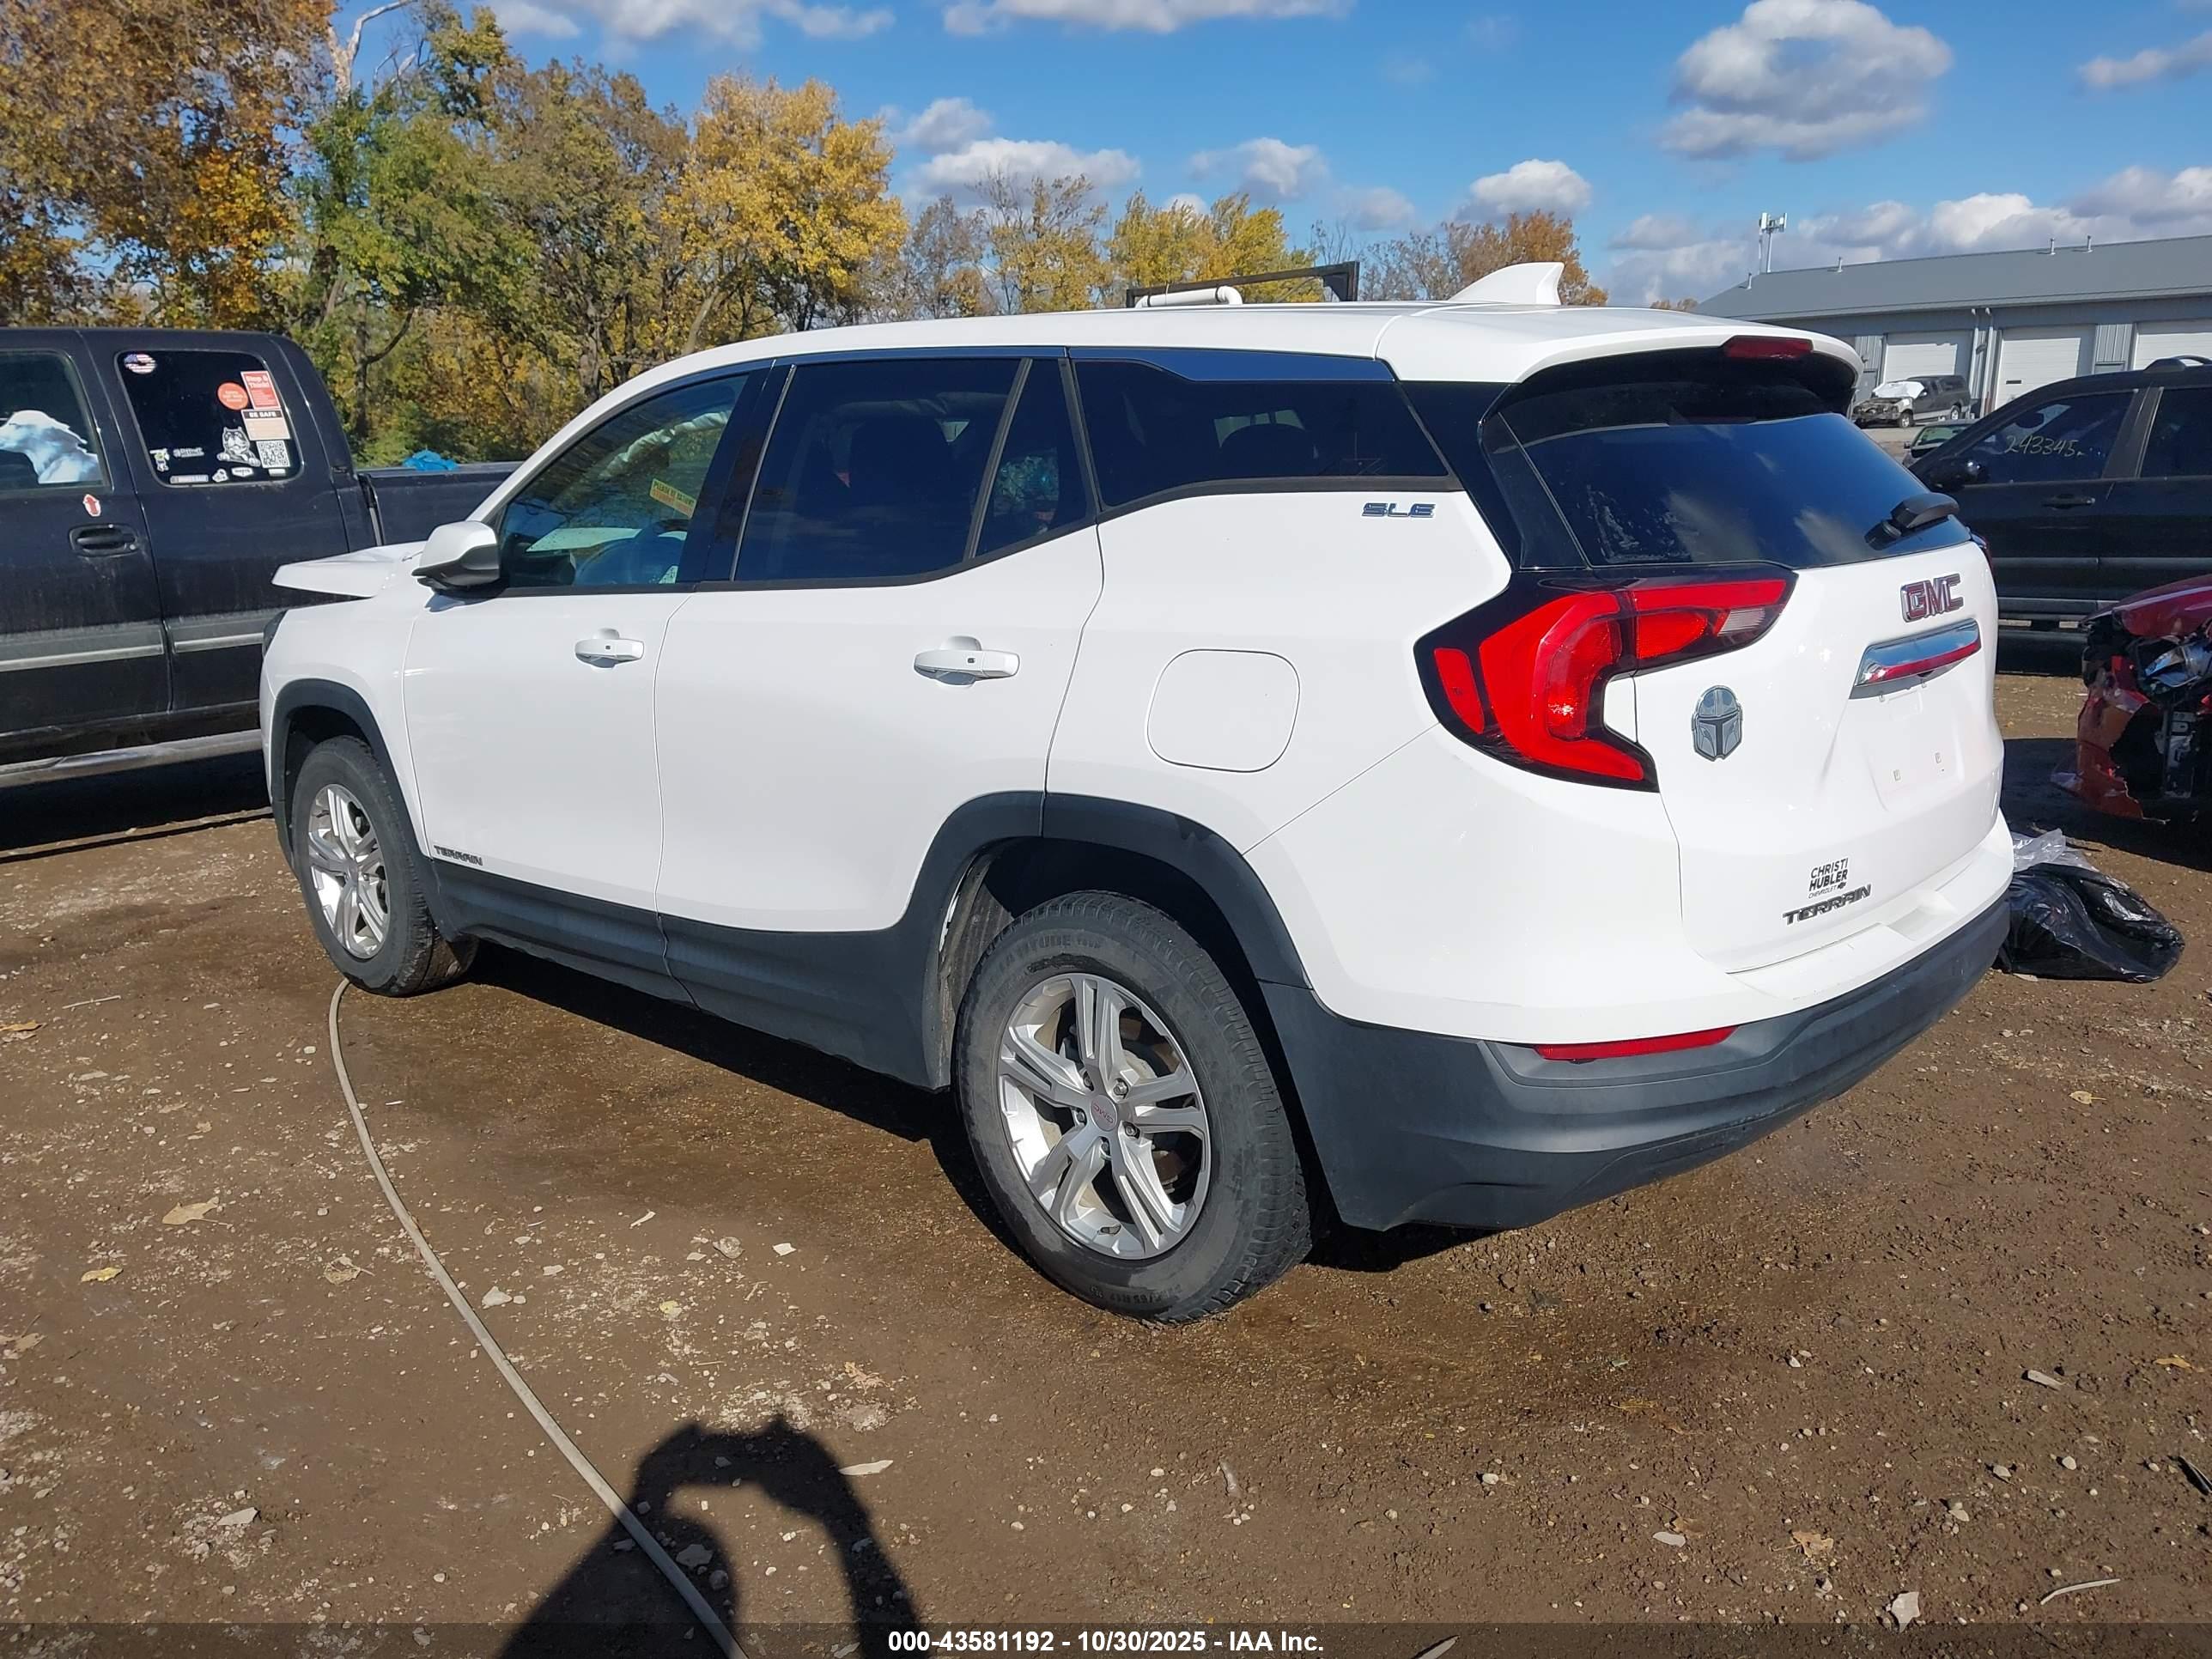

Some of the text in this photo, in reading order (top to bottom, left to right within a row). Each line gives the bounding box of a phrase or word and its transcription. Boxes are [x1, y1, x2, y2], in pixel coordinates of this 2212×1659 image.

[1362, 502, 1436, 518] SLE
[1900, 573, 1964, 623] GMC
[434, 844, 483, 866] TERRAIN
[1810, 858, 1848, 878] CHRISTI
[1808, 869, 1848, 891] HUBLER
[1808, 884, 1837, 899] CHEVROLET
[1783, 884, 1871, 926] TERRAIN
[1093, 1103, 1114, 1124] GMC
